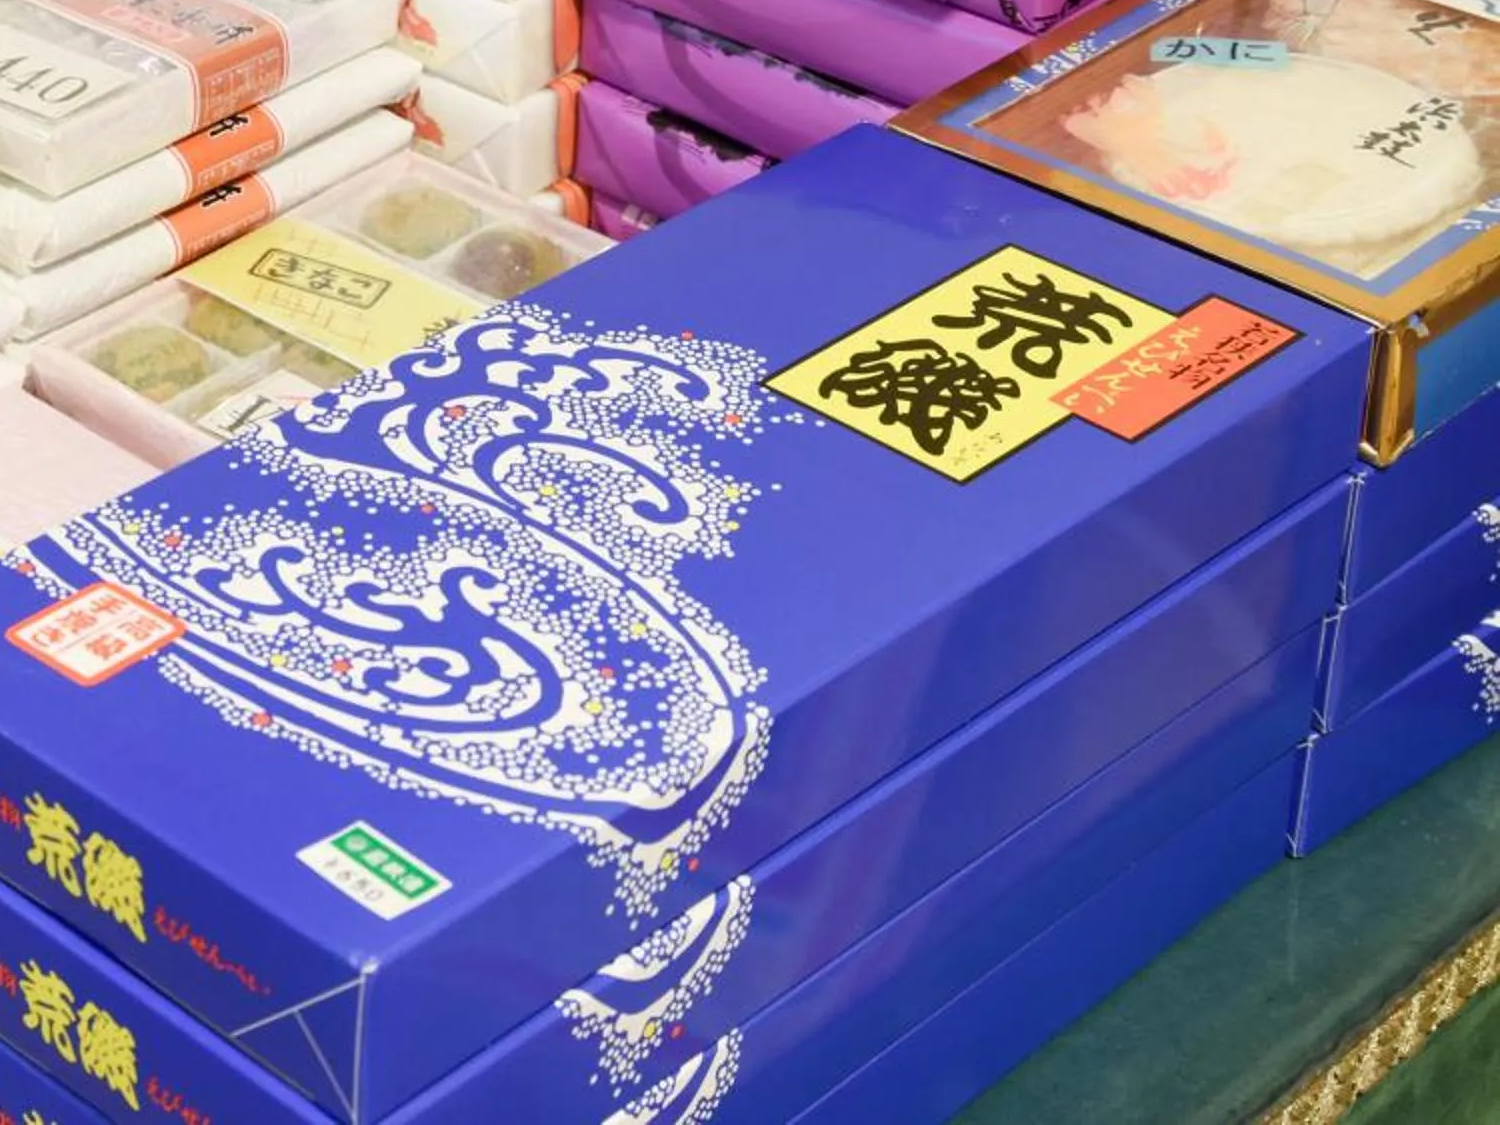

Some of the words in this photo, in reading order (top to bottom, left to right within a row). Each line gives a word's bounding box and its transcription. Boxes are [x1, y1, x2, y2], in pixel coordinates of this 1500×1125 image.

[1165, 39, 1275, 61] かに
[268, 256, 373, 301] きなこ
[23, 791, 148, 945] 荒磯
[18, 958, 141, 1113] 荒磯
